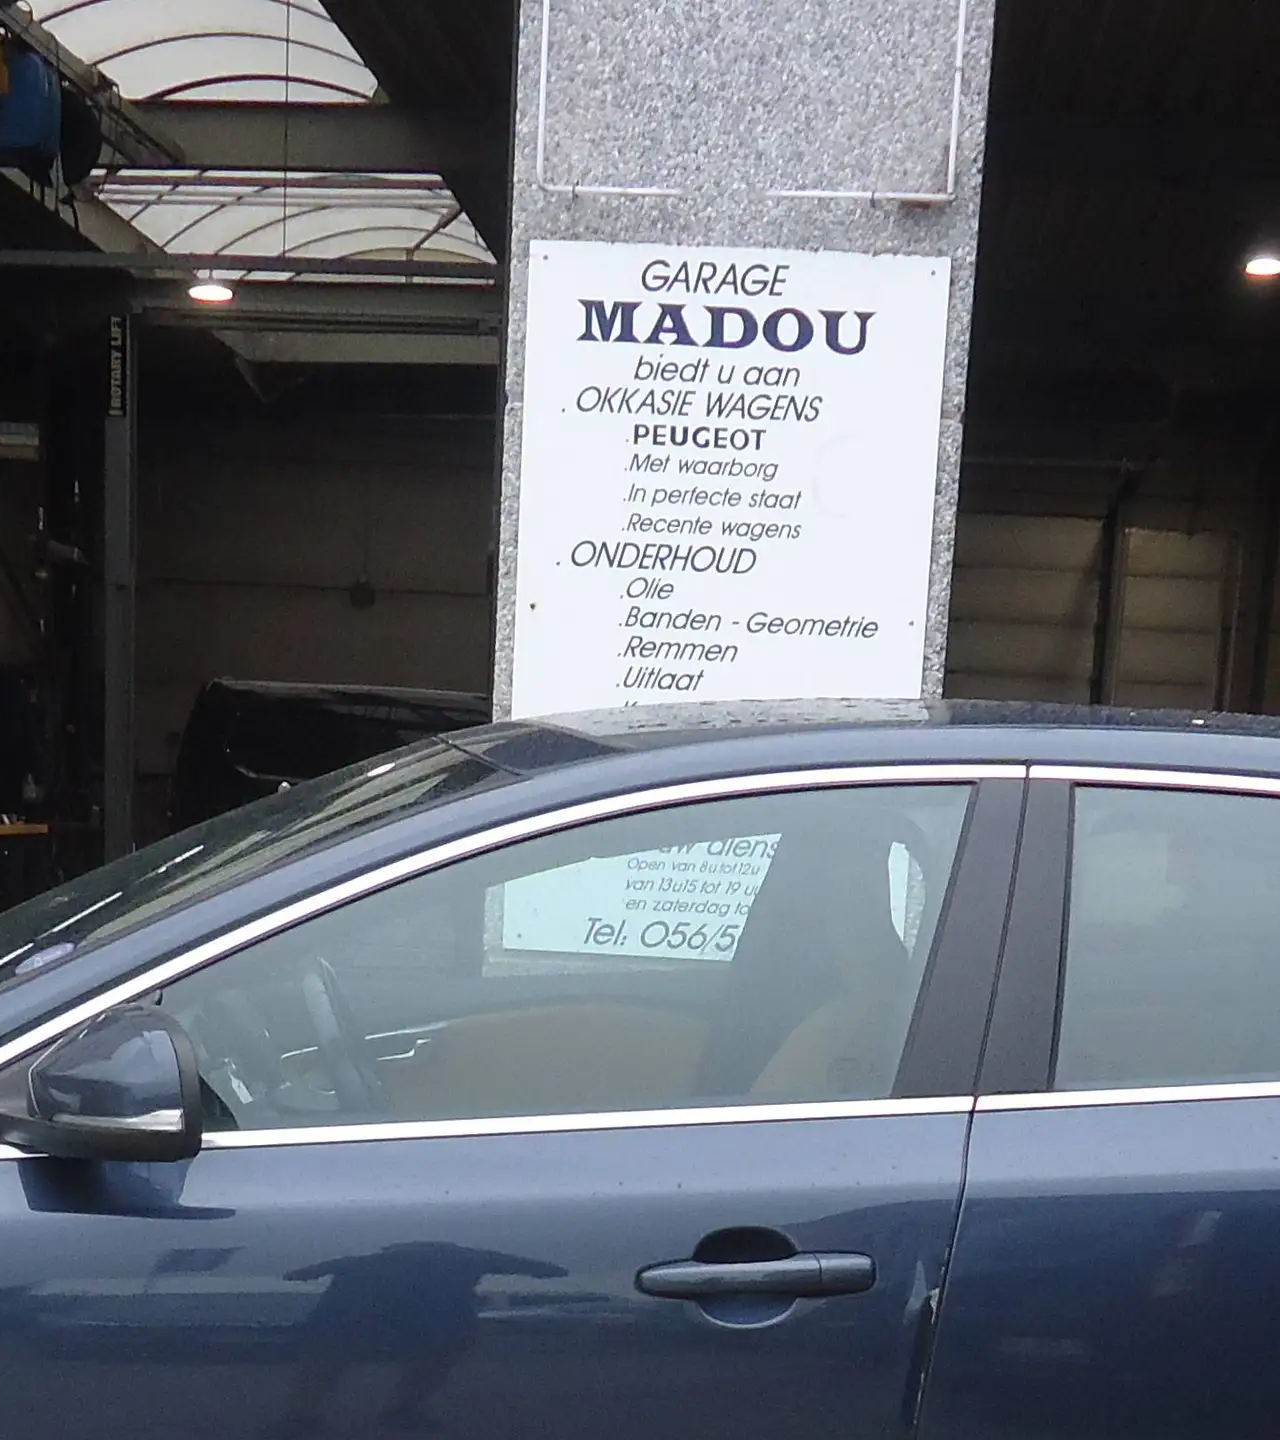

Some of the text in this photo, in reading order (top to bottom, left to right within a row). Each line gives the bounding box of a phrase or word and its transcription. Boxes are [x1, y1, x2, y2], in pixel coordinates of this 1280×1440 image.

[641, 259, 790, 297] GARAGE
[576, 298, 876, 356] MADOU
[110, 315, 122, 408] ROTARY LIFT
[633, 353, 801, 388] biedt u aan
[576, 385, 824, 423] OKKASIE WAGENS
[678, 457, 779, 483] waarborg
[650, 486, 742, 507] perfecte
[748, 489, 802, 510] staat
[721, 521, 802, 542] wagens
[570, 540, 757, 575] ONDERHOUD
[746, 611, 879, 639] Geometrie
[627, 858, 666, 871] Open
[672, 861, 696, 872] van
[625, 877, 654, 891] van
[700, 880, 721, 894] tot
[725, 881, 741, 895] 19
[625, 899, 647, 911] en
[652, 899, 730, 917] zaterdag
